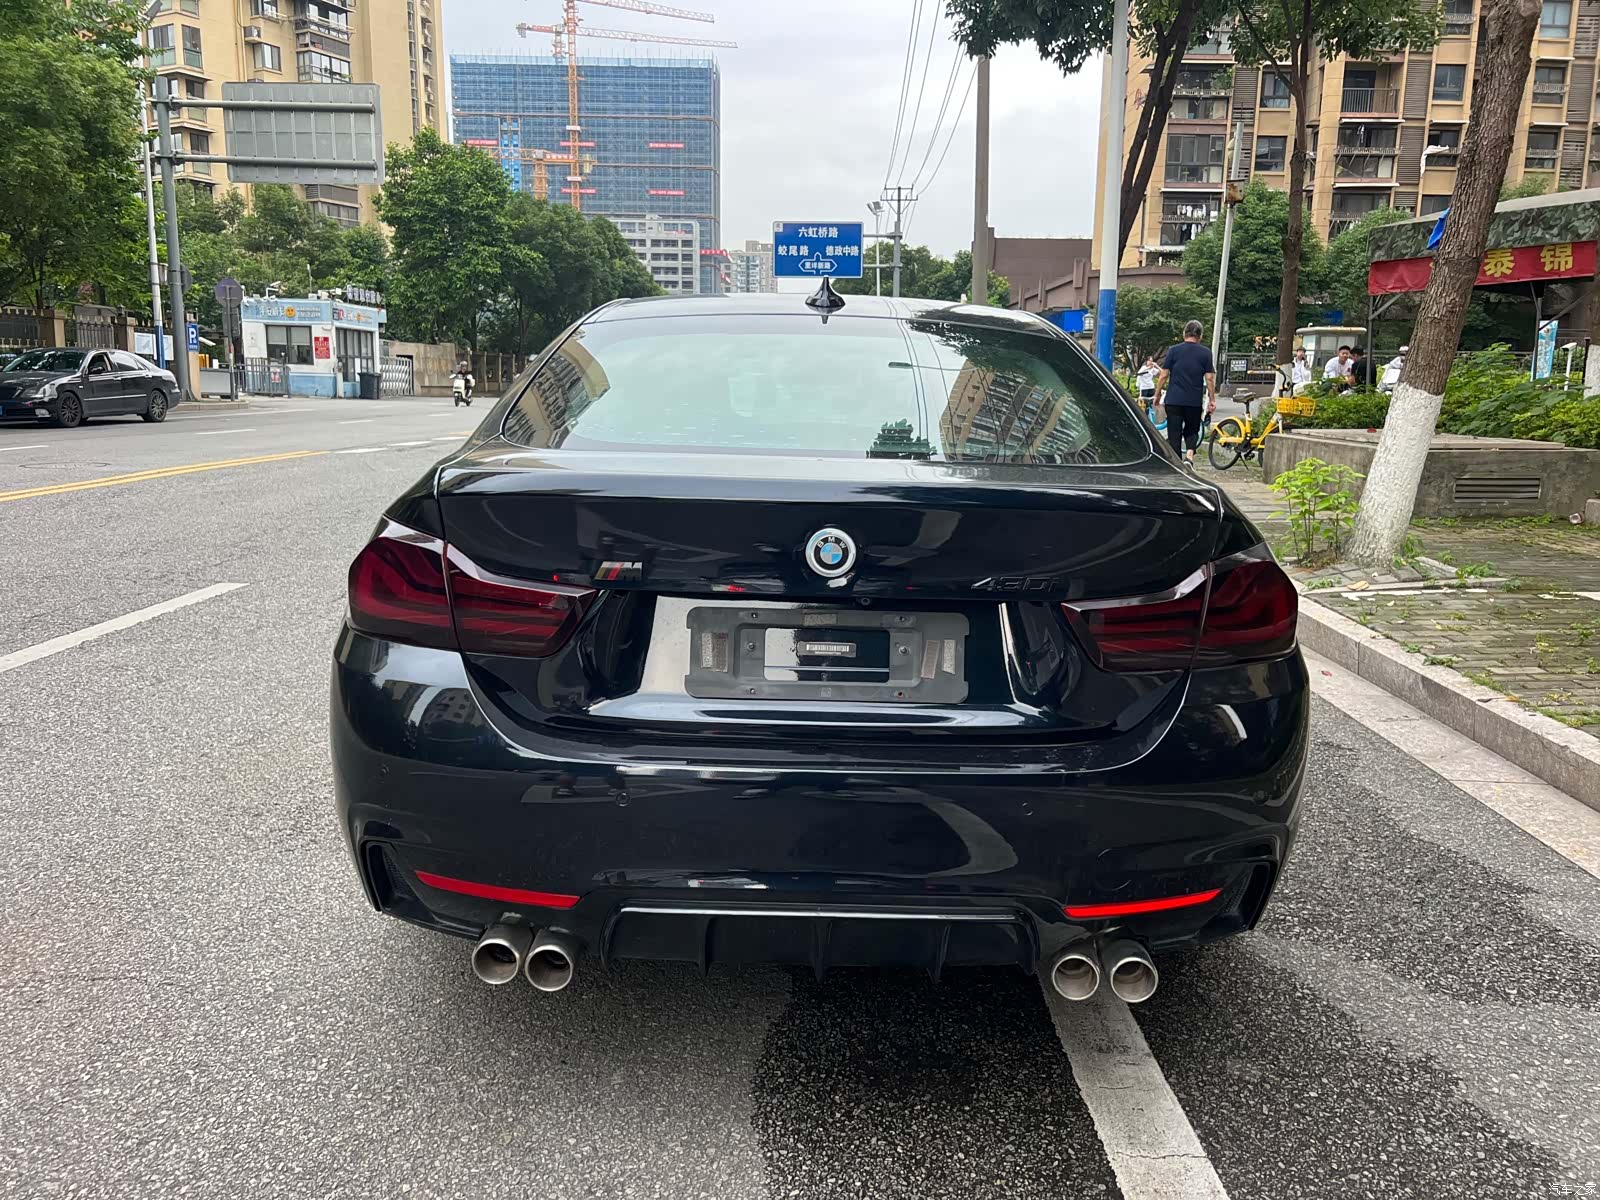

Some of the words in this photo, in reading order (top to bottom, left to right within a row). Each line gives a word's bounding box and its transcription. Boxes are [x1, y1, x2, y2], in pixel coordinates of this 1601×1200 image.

[798, 227, 838, 238] 六虹桥路
[778, 245, 809, 256] 蛟尾路
[825, 245, 859, 256] 德政中路
[1429, 243, 1573, 277] 泰锦
[188, 327, 197, 343] P
[816, 536, 847, 549] BMW
[971, 576, 1060, 592] 430i
